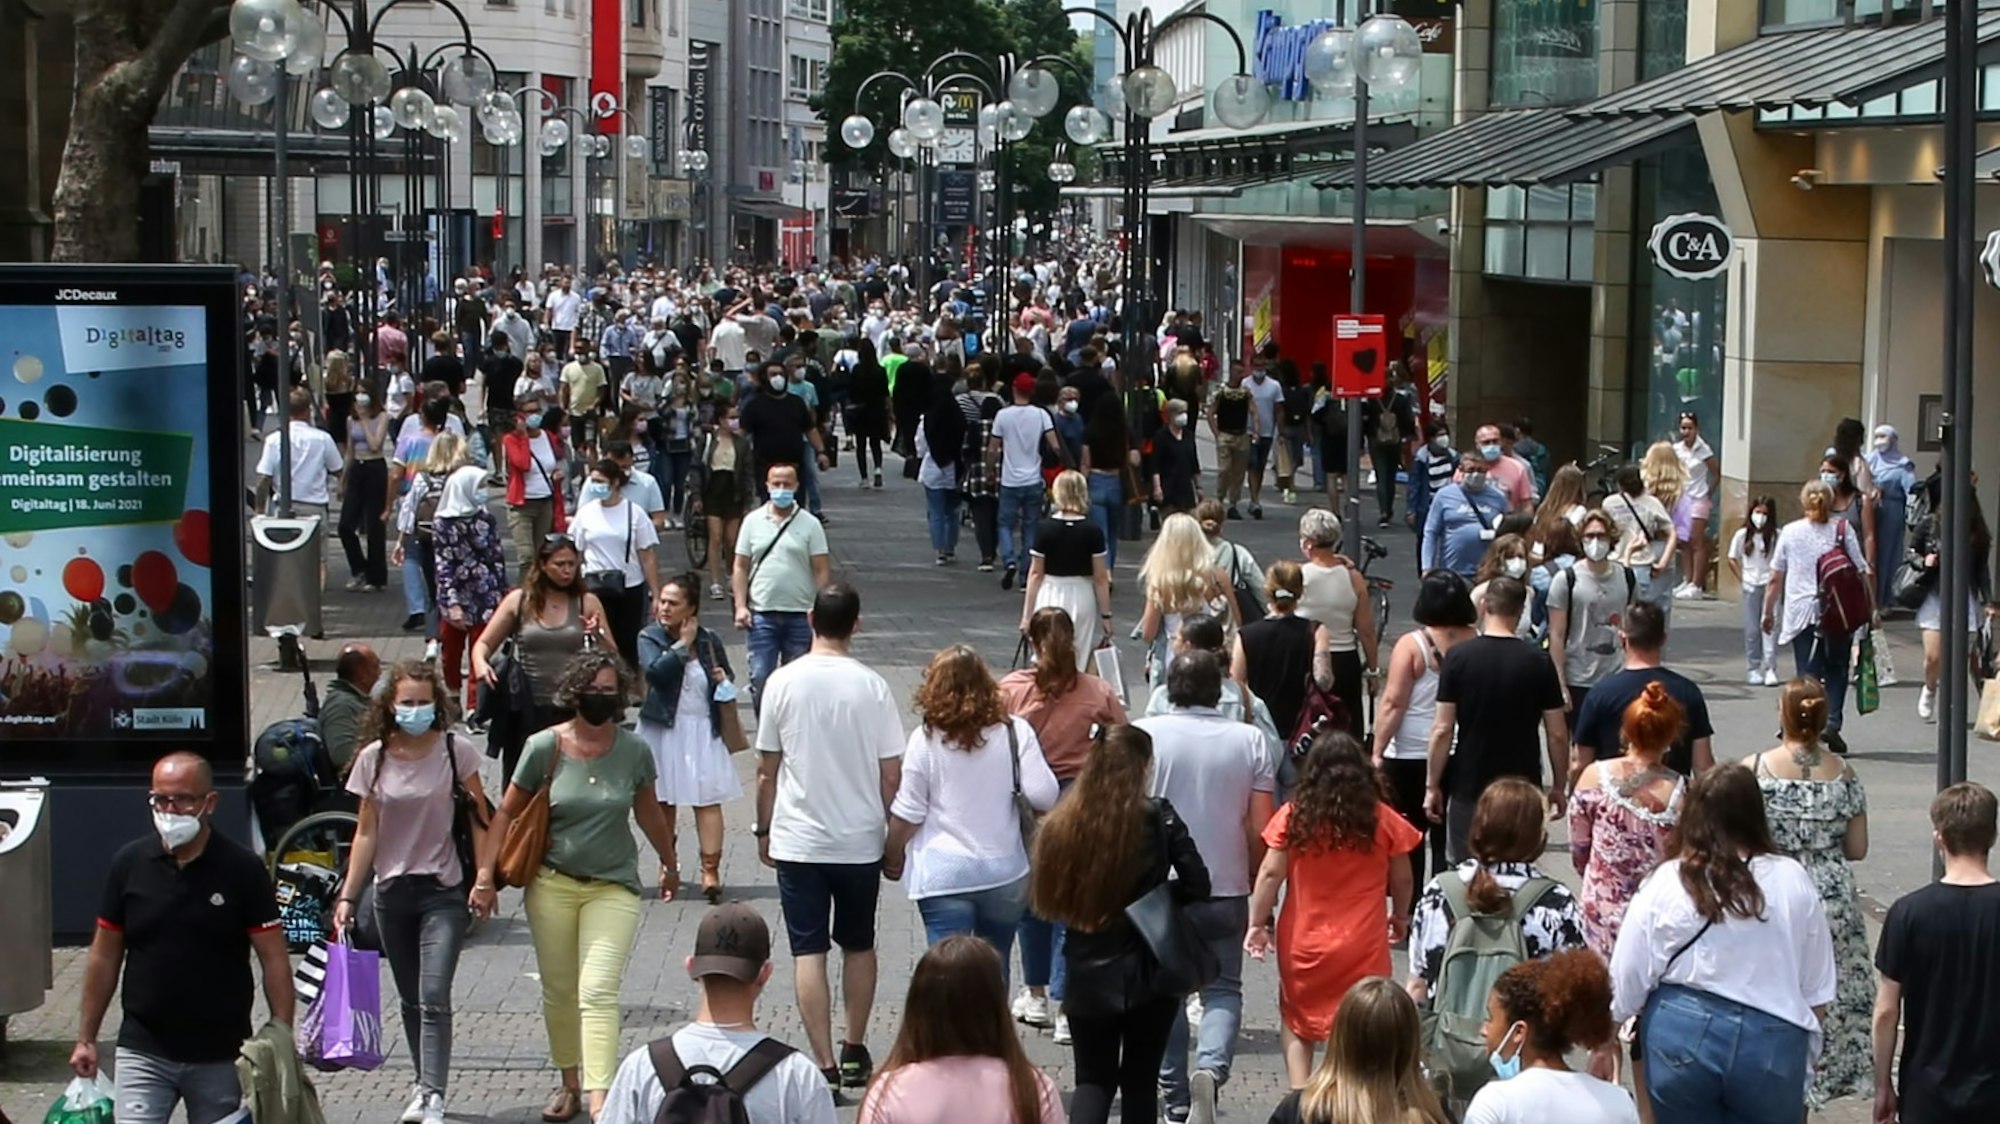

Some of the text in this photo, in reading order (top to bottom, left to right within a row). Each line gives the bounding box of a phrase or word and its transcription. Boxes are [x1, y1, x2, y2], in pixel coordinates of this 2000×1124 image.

[1668, 232, 1722, 260] C&A
[55, 289, 118, 301] JCDecaux
[86, 326, 185, 348] Digitaltag
[10, 445, 142, 467] Digitalisierung
[0, 470, 172, 491] meinsam gestalten
[11, 499, 67, 512] Digitaltag
[75, 499, 91, 510] 18.
[92, 499, 116, 510] Juni
[118, 499, 142, 510] 2021
